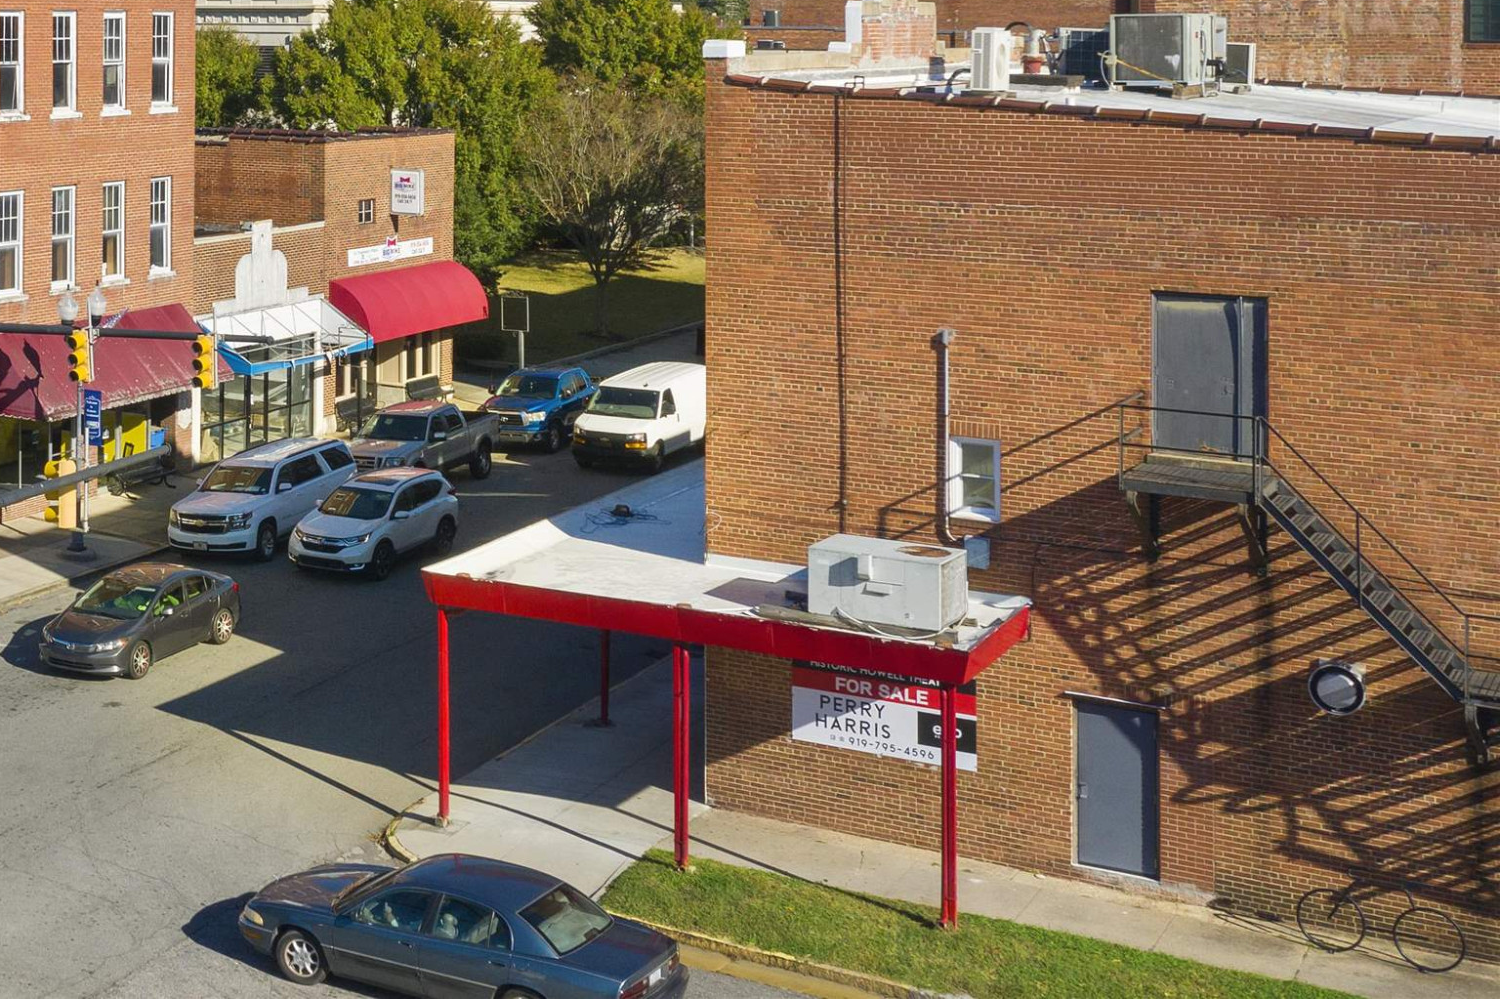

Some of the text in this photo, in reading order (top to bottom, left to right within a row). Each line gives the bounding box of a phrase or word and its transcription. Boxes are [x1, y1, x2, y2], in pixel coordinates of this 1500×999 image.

[835, 676, 929, 705] FOR SALE
[820, 694, 885, 719] PERRY
[815, 713, 891, 739] HARRIS
[848, 737, 935, 760] 919-795-4596
